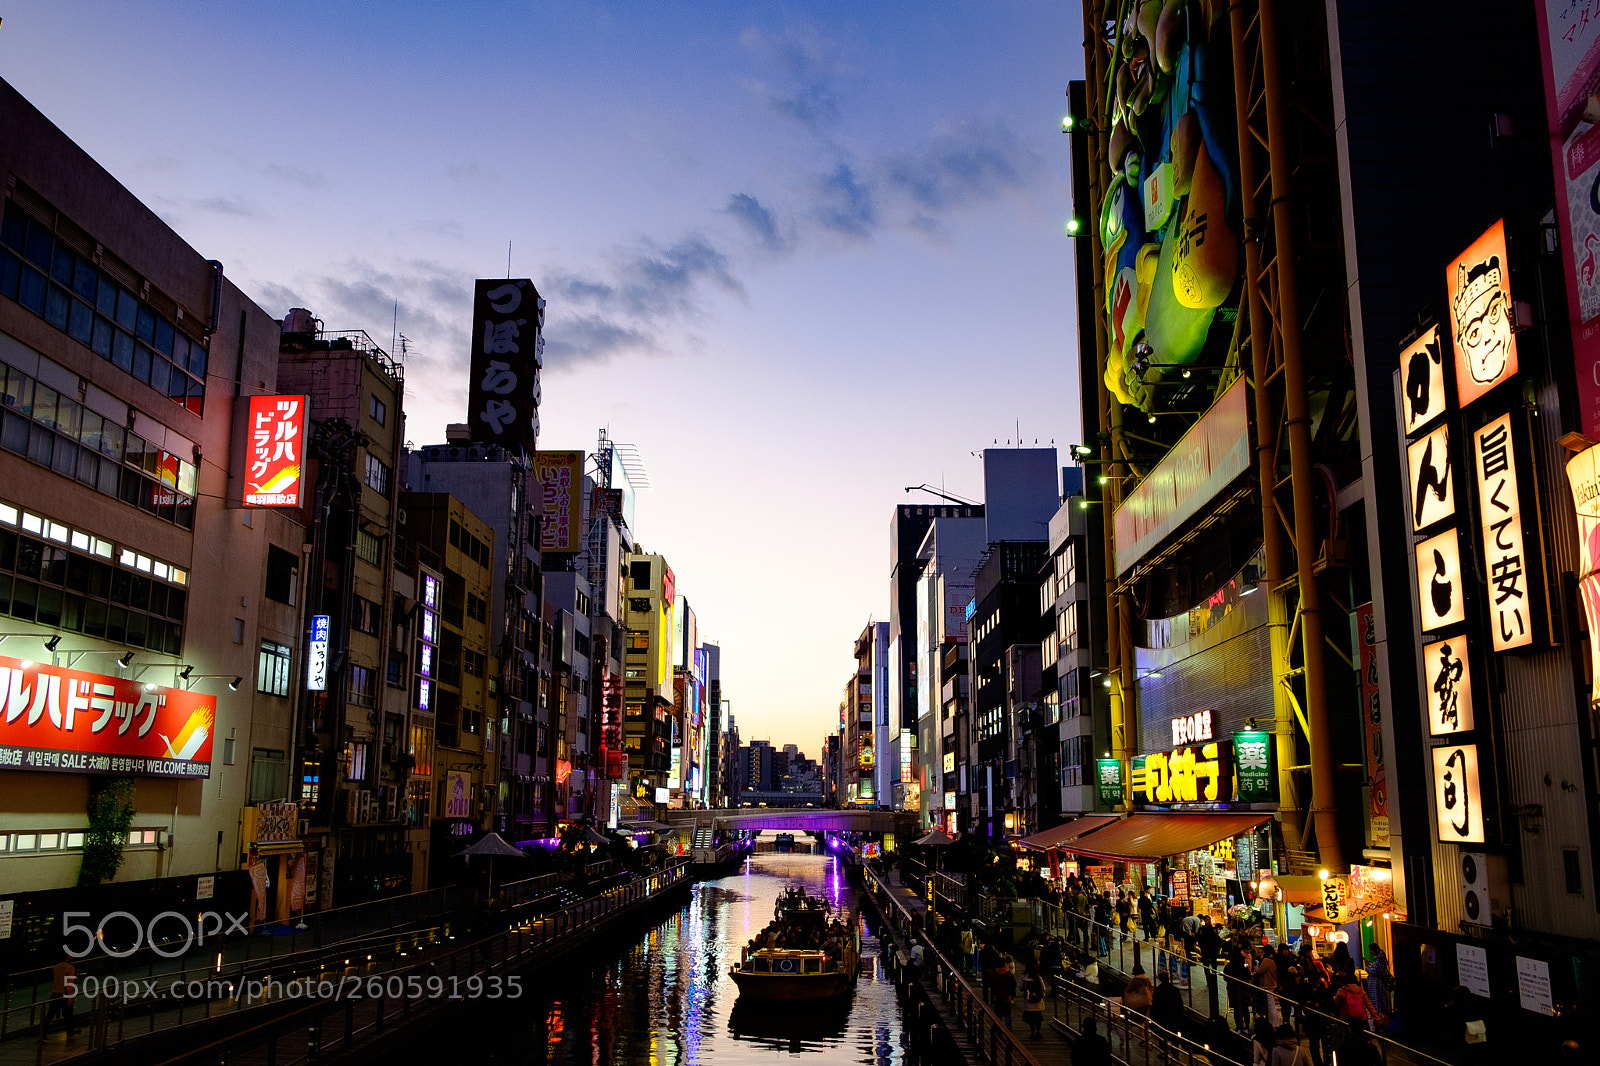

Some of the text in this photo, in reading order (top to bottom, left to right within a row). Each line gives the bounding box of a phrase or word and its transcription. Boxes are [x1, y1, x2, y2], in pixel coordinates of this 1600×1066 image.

[251, 411, 275, 479] ドラッグ
[272, 400, 298, 462] ツルハ
[541, 467, 558, 547] いちごナビ
[1479, 421, 1526, 642] 旨くて安い
[949, 606, 967, 614] DE
[316, 617, 328, 641] 焼肉
[313, 643, 326, 688] いろりや
[0, 666, 167, 738] ルハドラッグ
[26, 750, 60, 767] 세일판매
[61, 752, 87, 770] SALE
[111, 757, 145, 773] 환영합니다
[147, 759, 186, 776] WELCOME
[1100, 765, 1120, 785] 薬
[1237, 742, 1268, 771] 薬
[1257, 778, 1271, 794] 약
